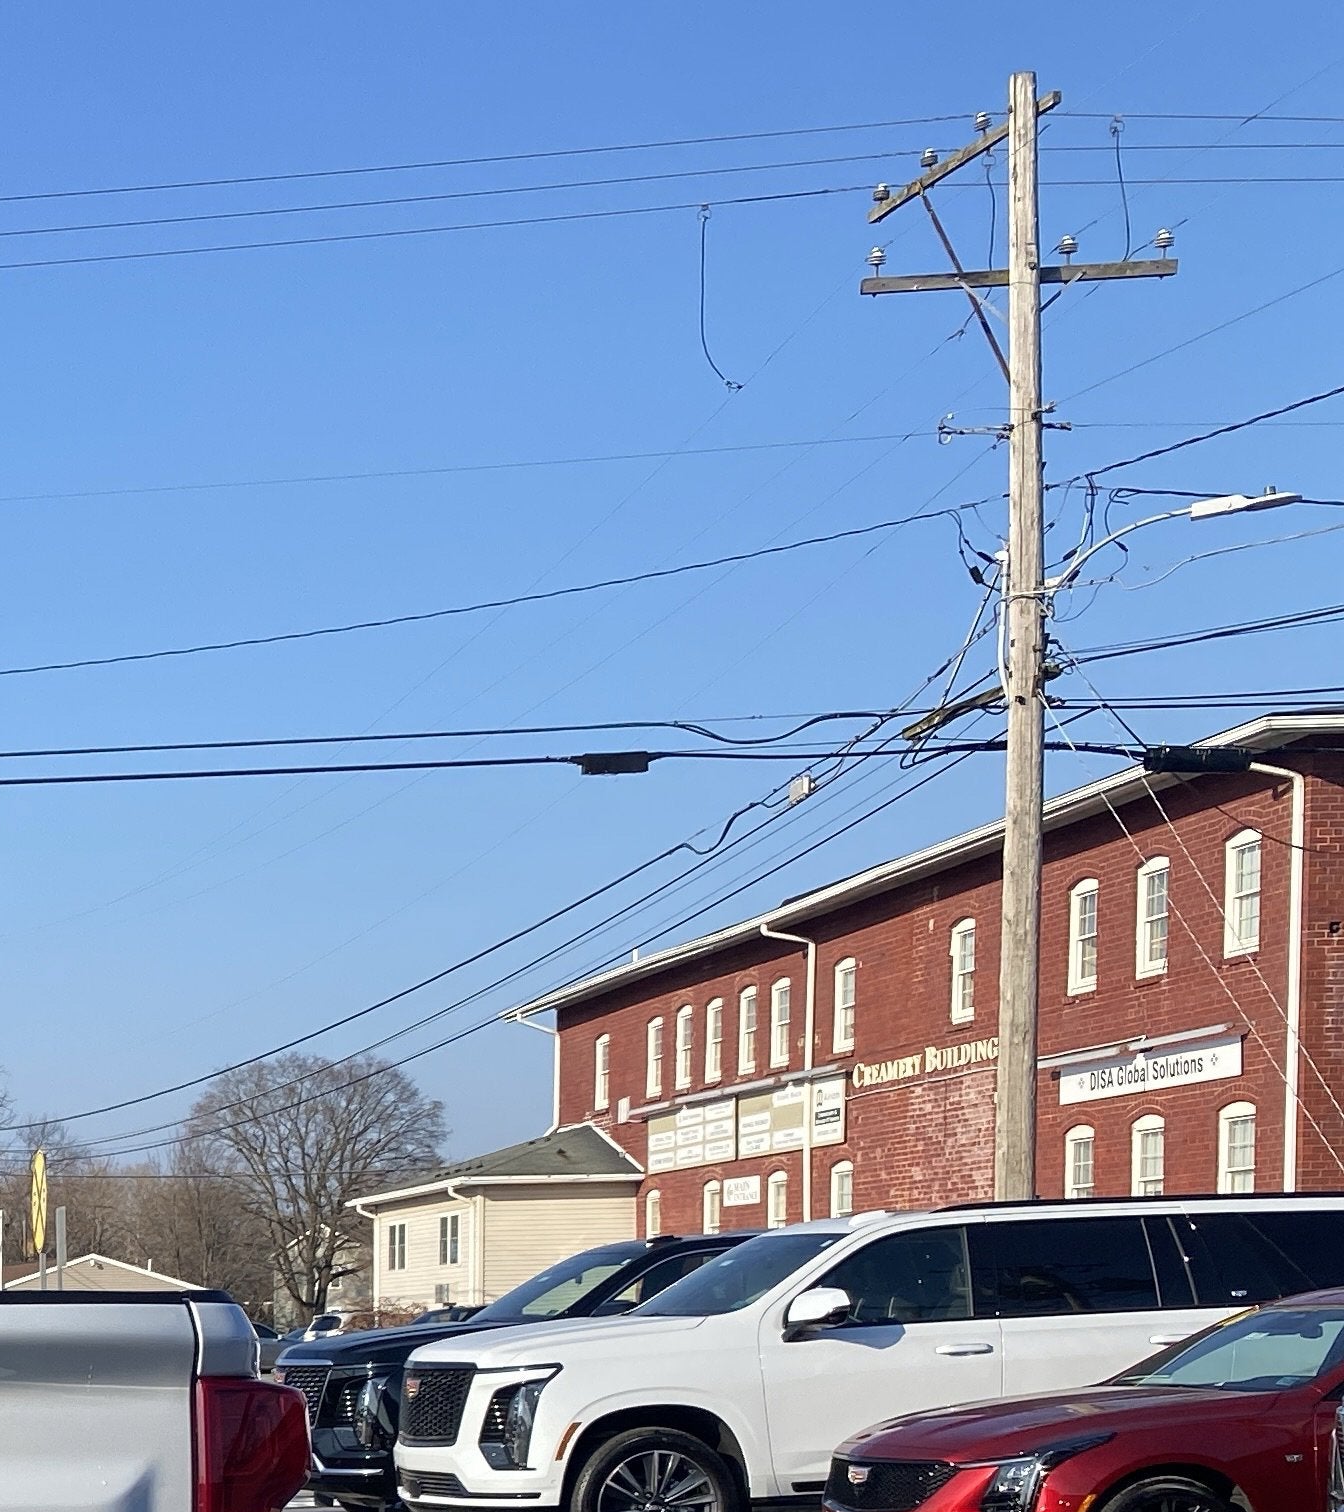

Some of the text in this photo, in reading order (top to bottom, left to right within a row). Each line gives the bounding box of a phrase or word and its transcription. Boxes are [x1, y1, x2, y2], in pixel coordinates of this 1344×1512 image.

[852, 1037, 1000, 1088] CREAMERY BUILDING
[1090, 1055, 1204, 1092] DISA Global Solutions
